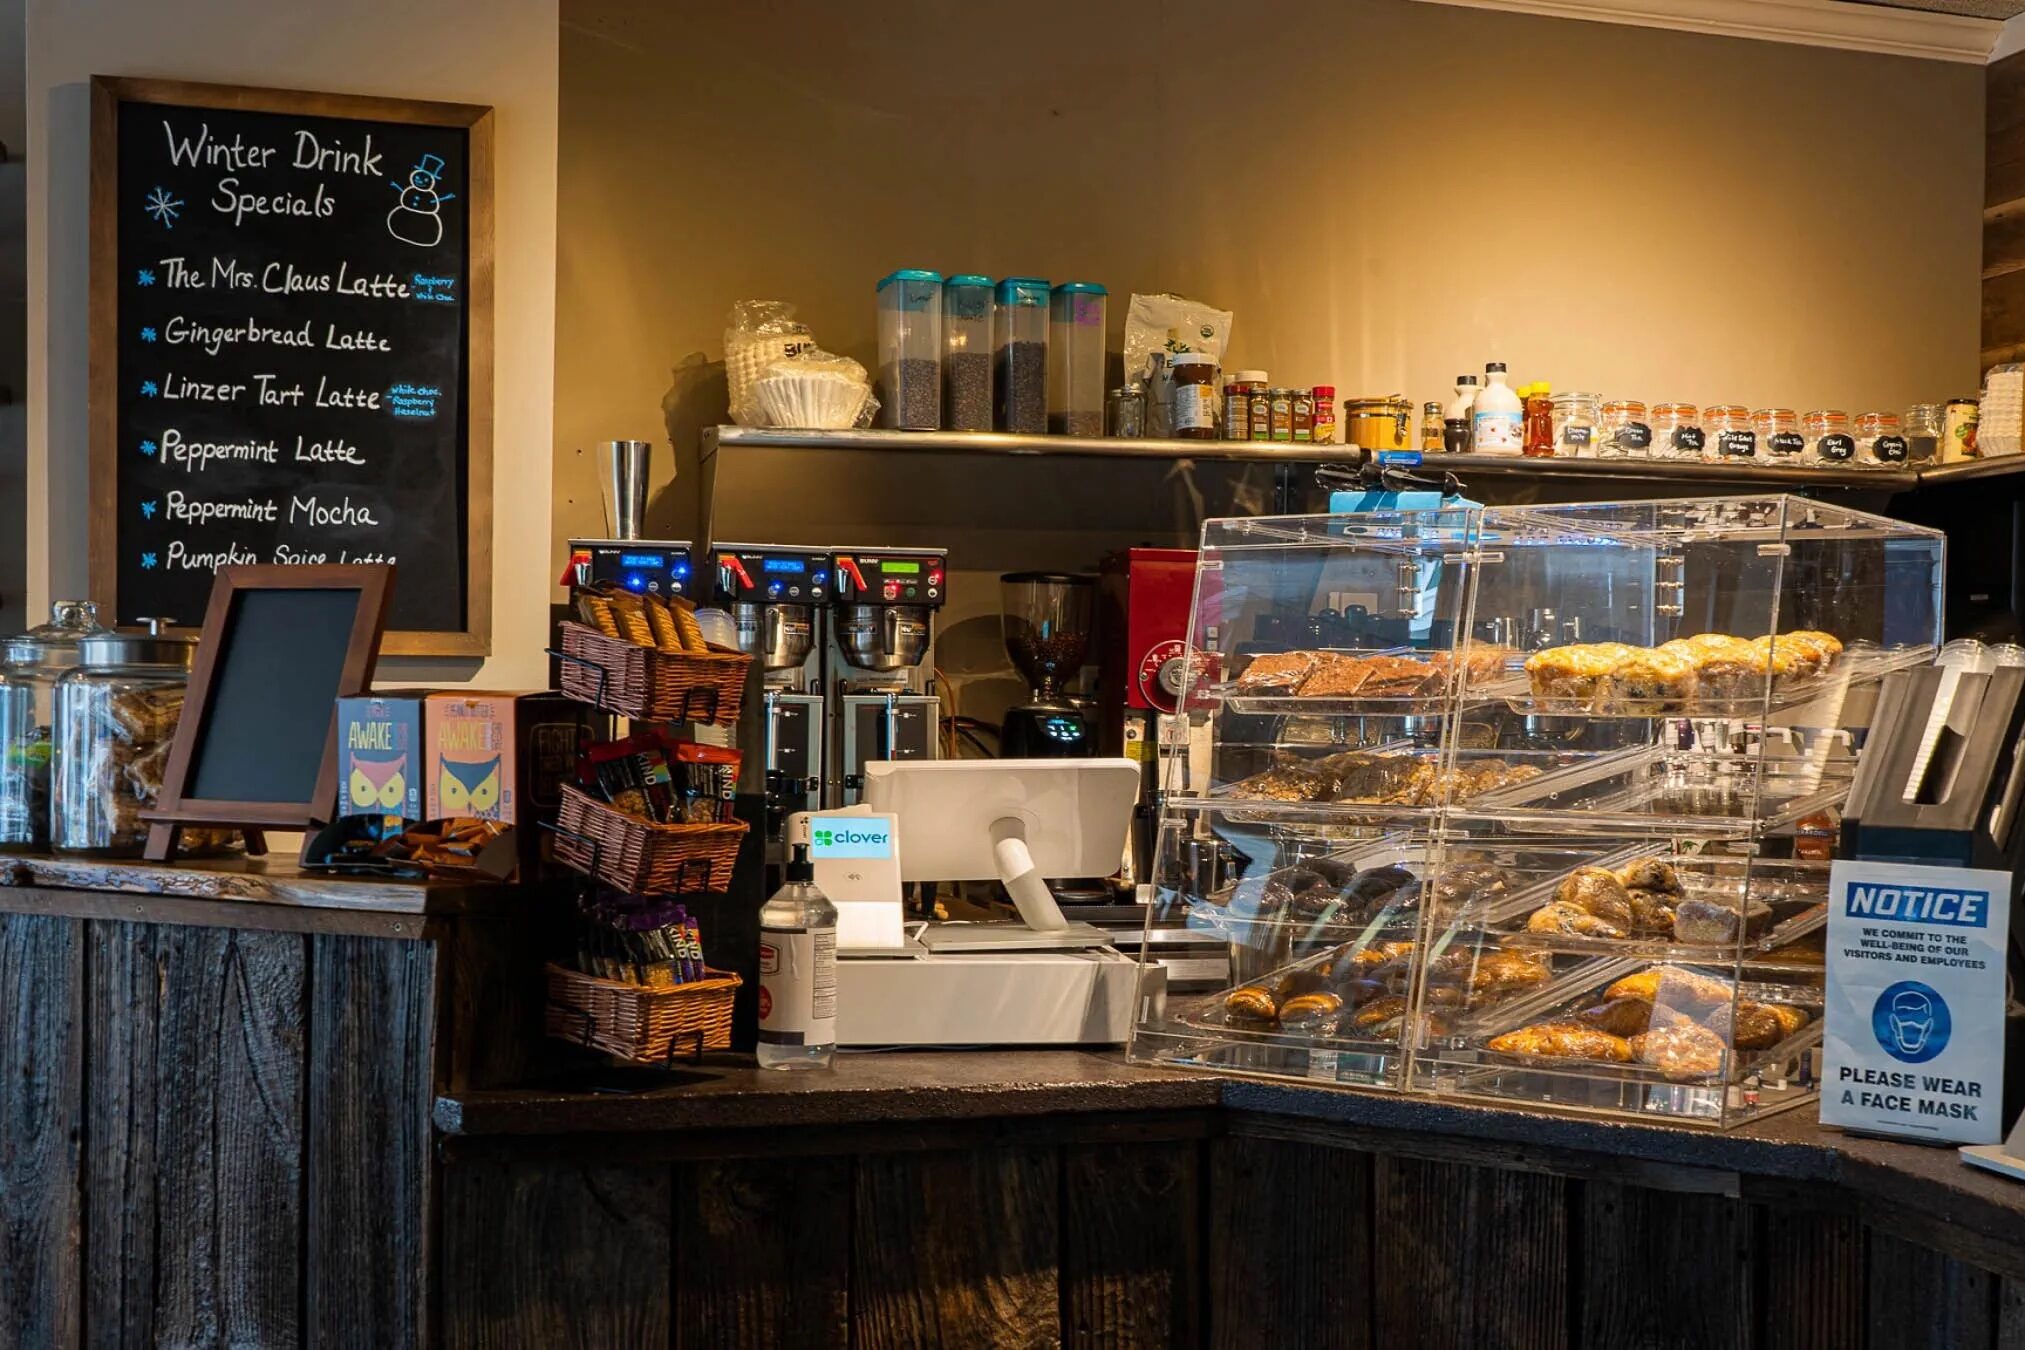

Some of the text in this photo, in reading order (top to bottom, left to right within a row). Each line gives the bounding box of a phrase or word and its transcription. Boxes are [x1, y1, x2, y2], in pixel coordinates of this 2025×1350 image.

[163, 120, 383, 177] Winter Drink
[211, 177, 335, 227] Specials
[159, 257, 411, 299] The Mrs. Claus Latte
[165, 316, 392, 356] Gingerbread Latte
[163, 373, 381, 410] Linzer Tart Latte
[160, 428, 367, 473] Peppermint Latte
[166, 490, 379, 527] Peppermint Mocha
[166, 540, 257, 576] Pumpkin
[347, 721, 393, 751] AWAKE
[438, 720, 487, 753] AWAKE
[635, 752, 657, 786] KIND
[719, 764, 734, 801] KIND
[834, 830, 888, 844] clover
[1850, 886, 1984, 922] NOTICE
[667, 926, 687, 959] KIND
[686, 928, 700, 961] KIND
[1860, 939, 1970, 957] WELL-BEING OF OUR
[1863, 927, 1967, 945] WE COMMIT TO THE
[1844, 949, 1987, 970] VISITORS AND EMPLOYEES
[1839, 1066, 1983, 1098] PLEASE WEAR
[1840, 1089, 1980, 1122] A FACE MASK
